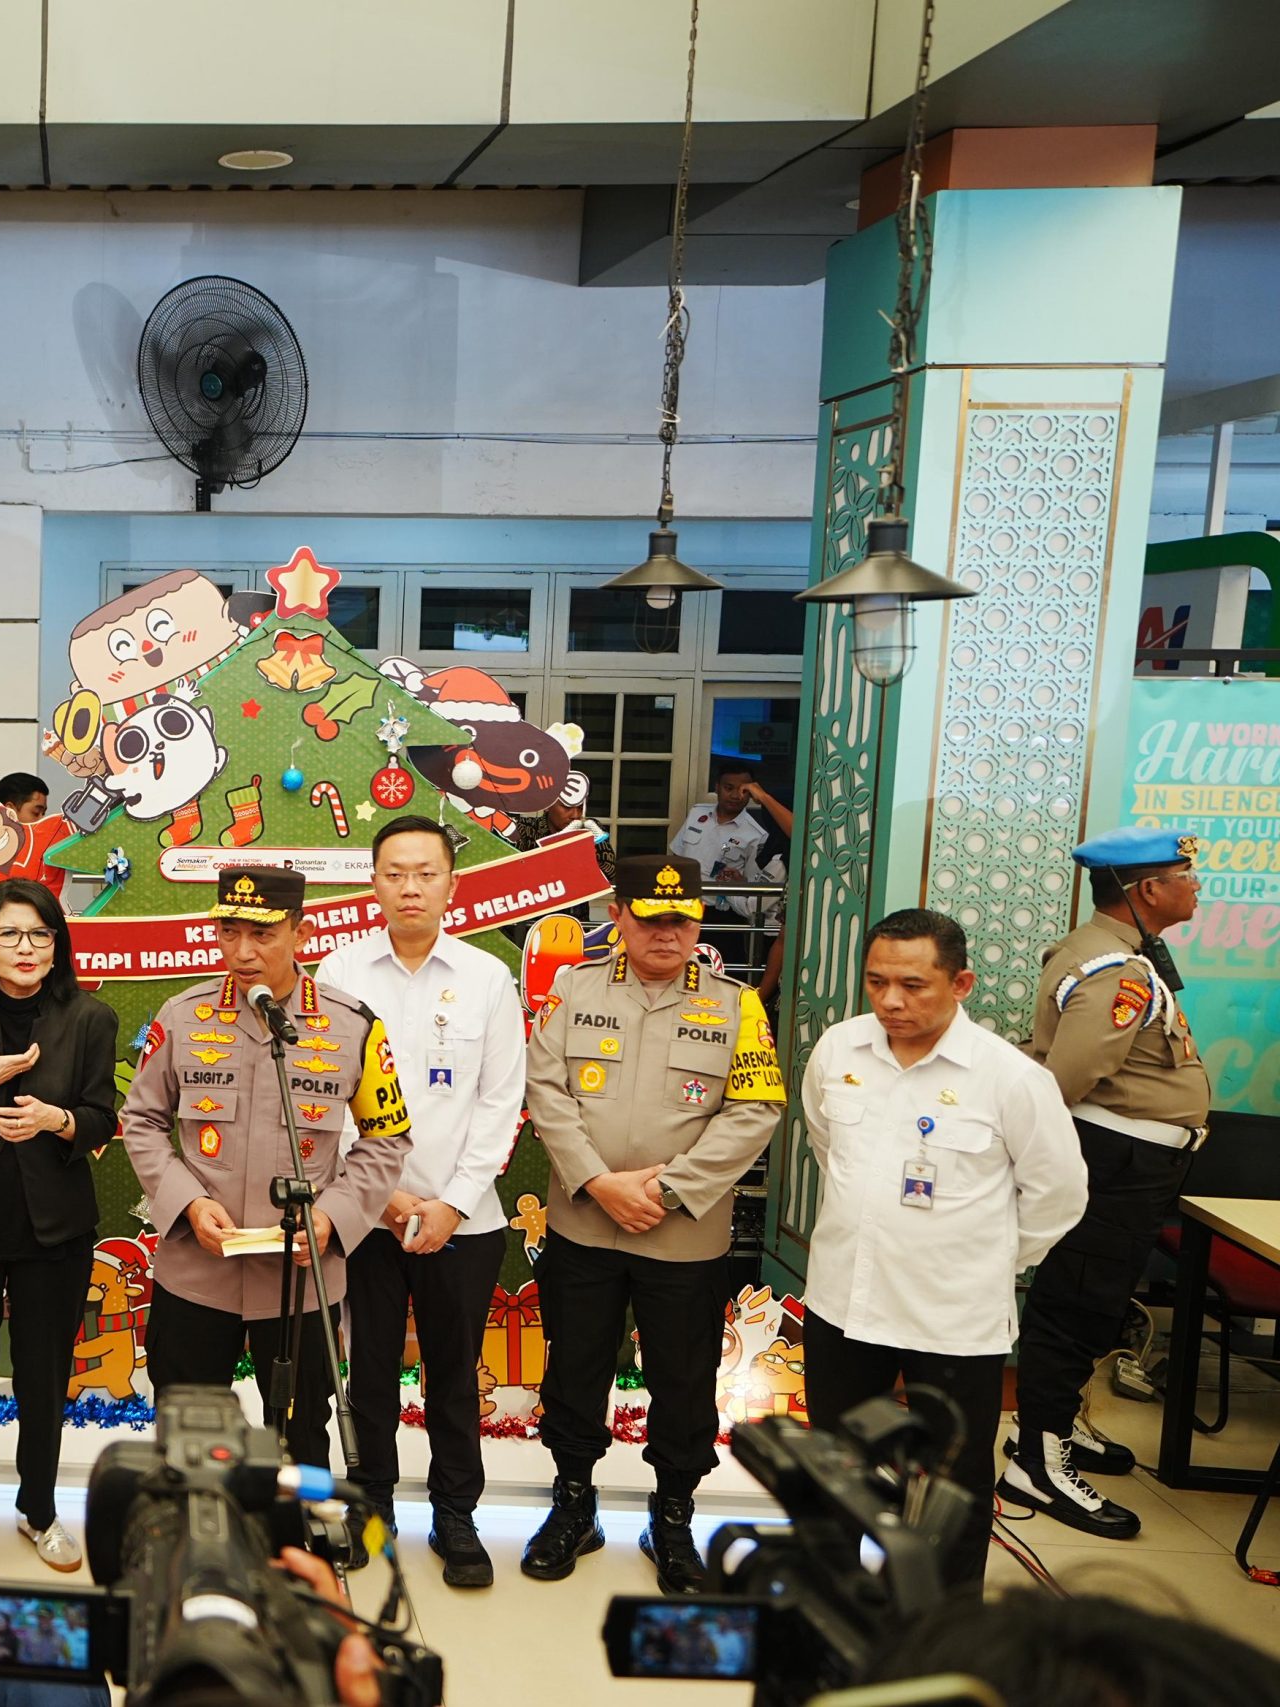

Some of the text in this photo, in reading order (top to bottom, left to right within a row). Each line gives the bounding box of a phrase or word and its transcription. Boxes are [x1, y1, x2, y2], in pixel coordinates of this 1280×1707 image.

[1145, 789, 1167, 809] IN
[75, 952, 132, 970] TAPI
[140, 949, 224, 969] HARAP
[473, 879, 566, 920] MELAJU
[1158, 900, 1280, 949] oise
[573, 1013, 620, 1030] FADIL
[677, 1027, 727, 1045] POLRI
[184, 1071, 235, 1085] L.SIGIT.P
[291, 1077, 340, 1096] POLRI
